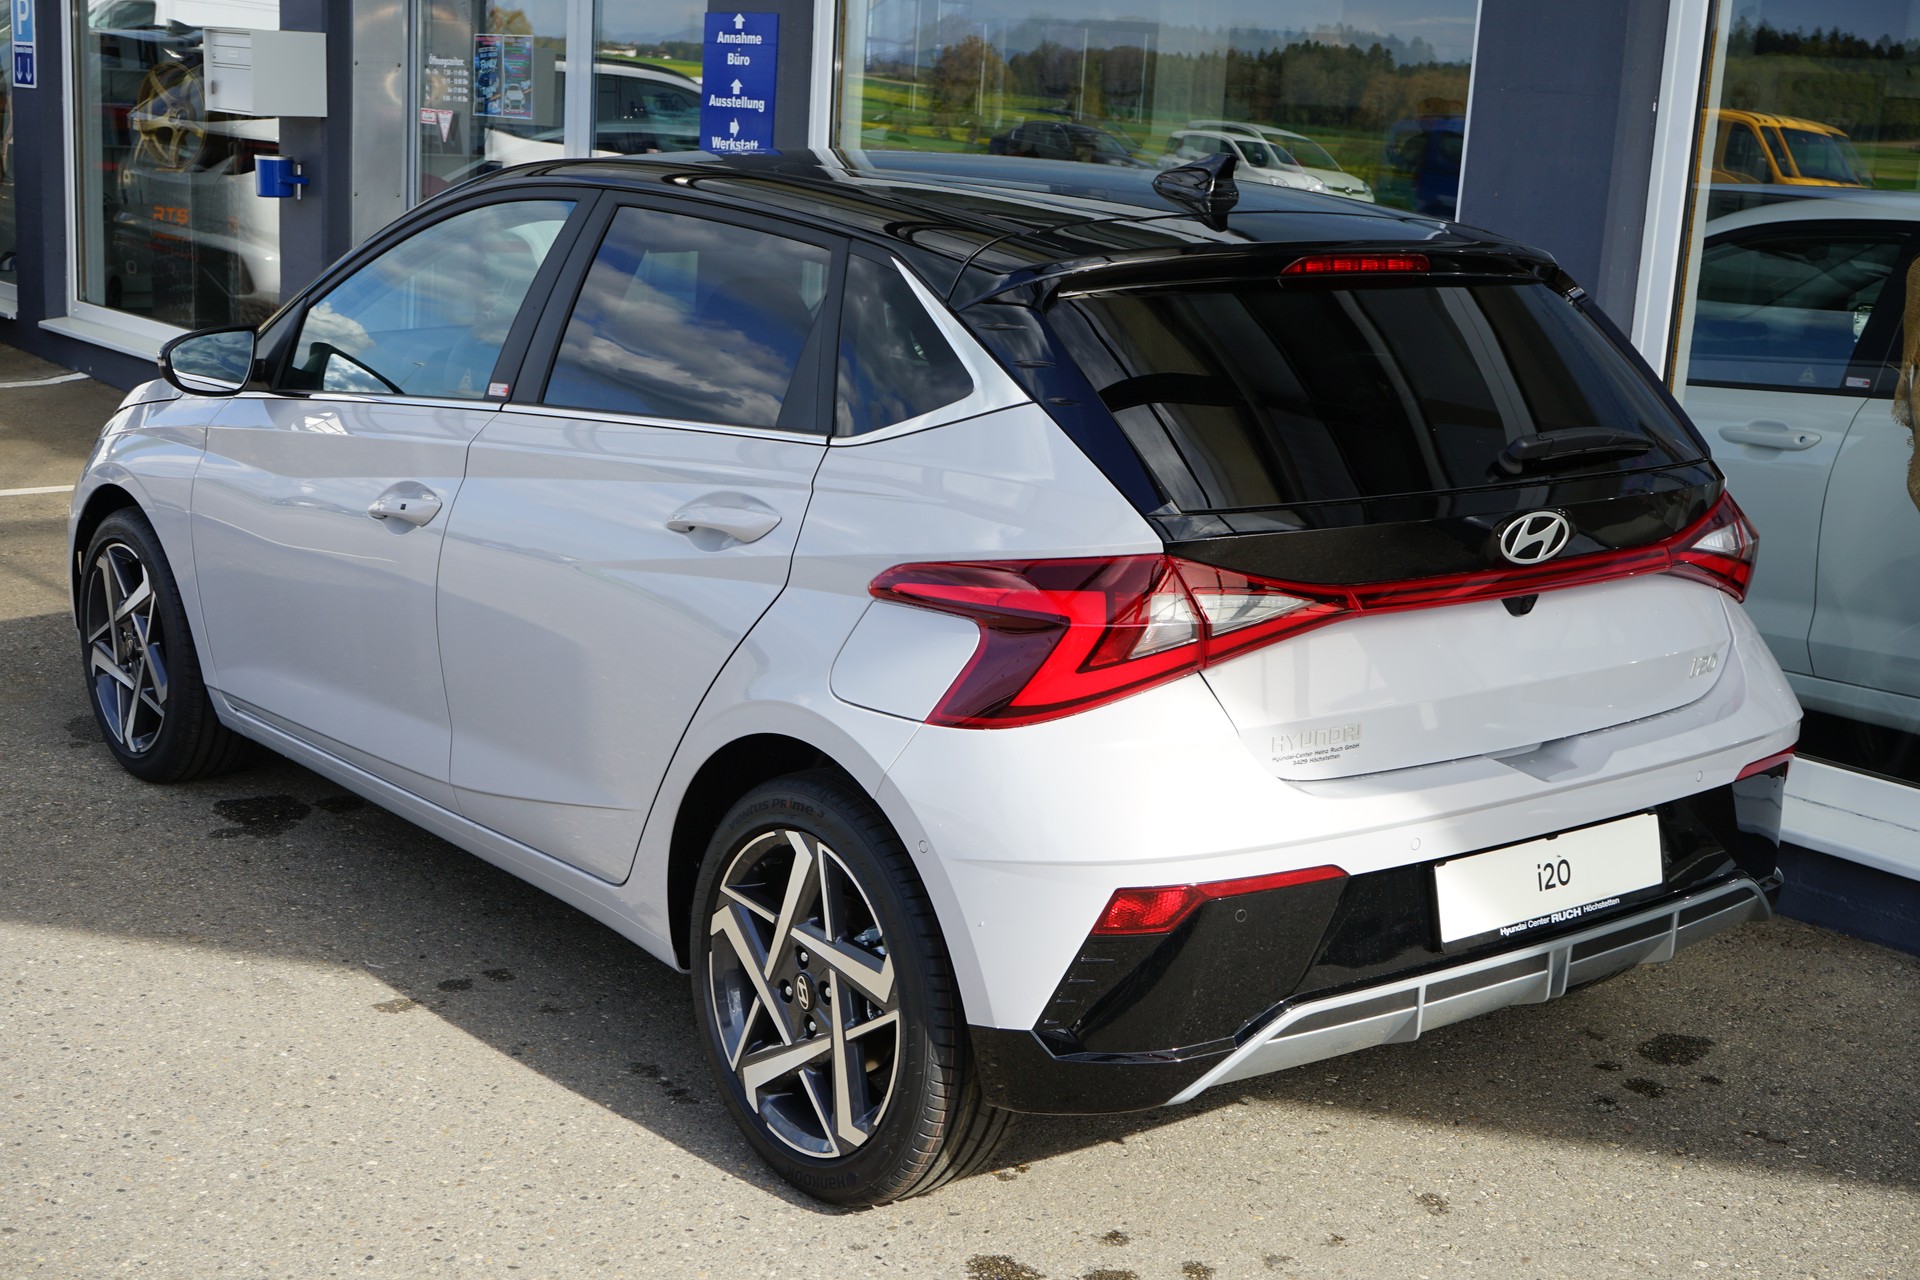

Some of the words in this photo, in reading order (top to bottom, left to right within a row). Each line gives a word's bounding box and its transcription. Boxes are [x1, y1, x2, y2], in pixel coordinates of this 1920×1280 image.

[17, 0, 29, 34] P
[717, 31, 762, 45] Annahme
[727, 52, 750, 66] Büro
[709, 94, 765, 113] Ausstellung
[711, 136, 759, 150] Werkstatt
[152, 205, 189, 224] RTS
[1689, 653, 1719, 679] i20
[1272, 724, 1361, 752] HYUNDAI
[1330, 746, 1344, 754] Ruch
[1345, 742, 1360, 751] GmbH
[1536, 858, 1571, 892] i20
[1500, 920, 1528, 936] Hyundai
[1527, 916, 1550, 929] Center
[1550, 906, 1582, 924] RUCH
[1583, 897, 1620, 913] Höchstetten
